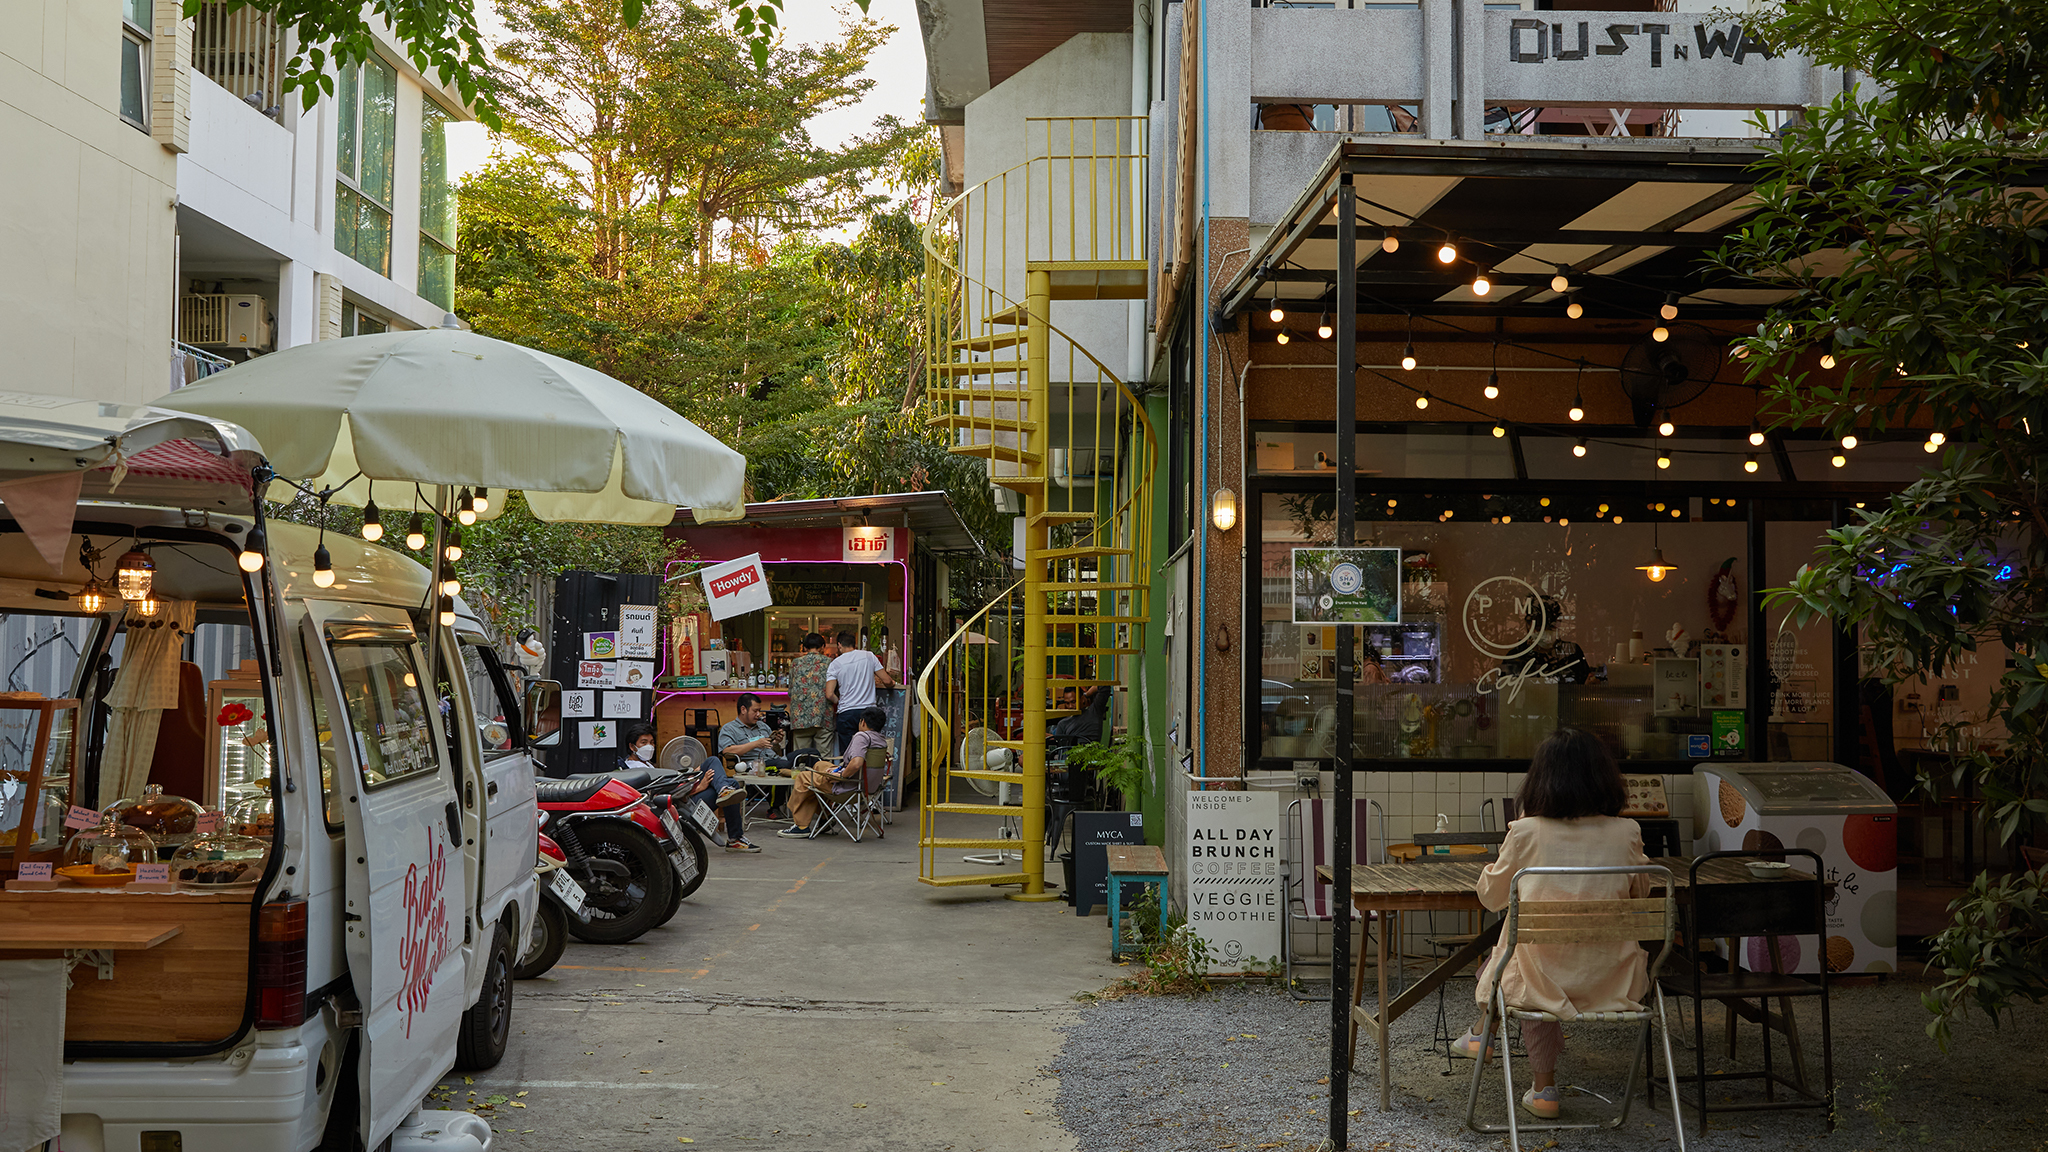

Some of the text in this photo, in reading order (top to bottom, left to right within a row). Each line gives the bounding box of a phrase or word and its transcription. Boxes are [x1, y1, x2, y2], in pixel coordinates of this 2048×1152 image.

[1479, 597, 1532, 615] P M
[625, 612, 651, 621] รถยนต์
[613, 703, 631, 712] YARD
[1192, 795, 1242, 803] WELCOME
[1096, 830, 1124, 839] MYCA
[1193, 828, 1274, 841] ALL DAY
[1192, 845, 1274, 858] BRUNCH
[1192, 861, 1276, 876] COFFEE
[1192, 892, 1276, 906] VEGGIE
[1192, 911, 1276, 921] SMOOTHIE
